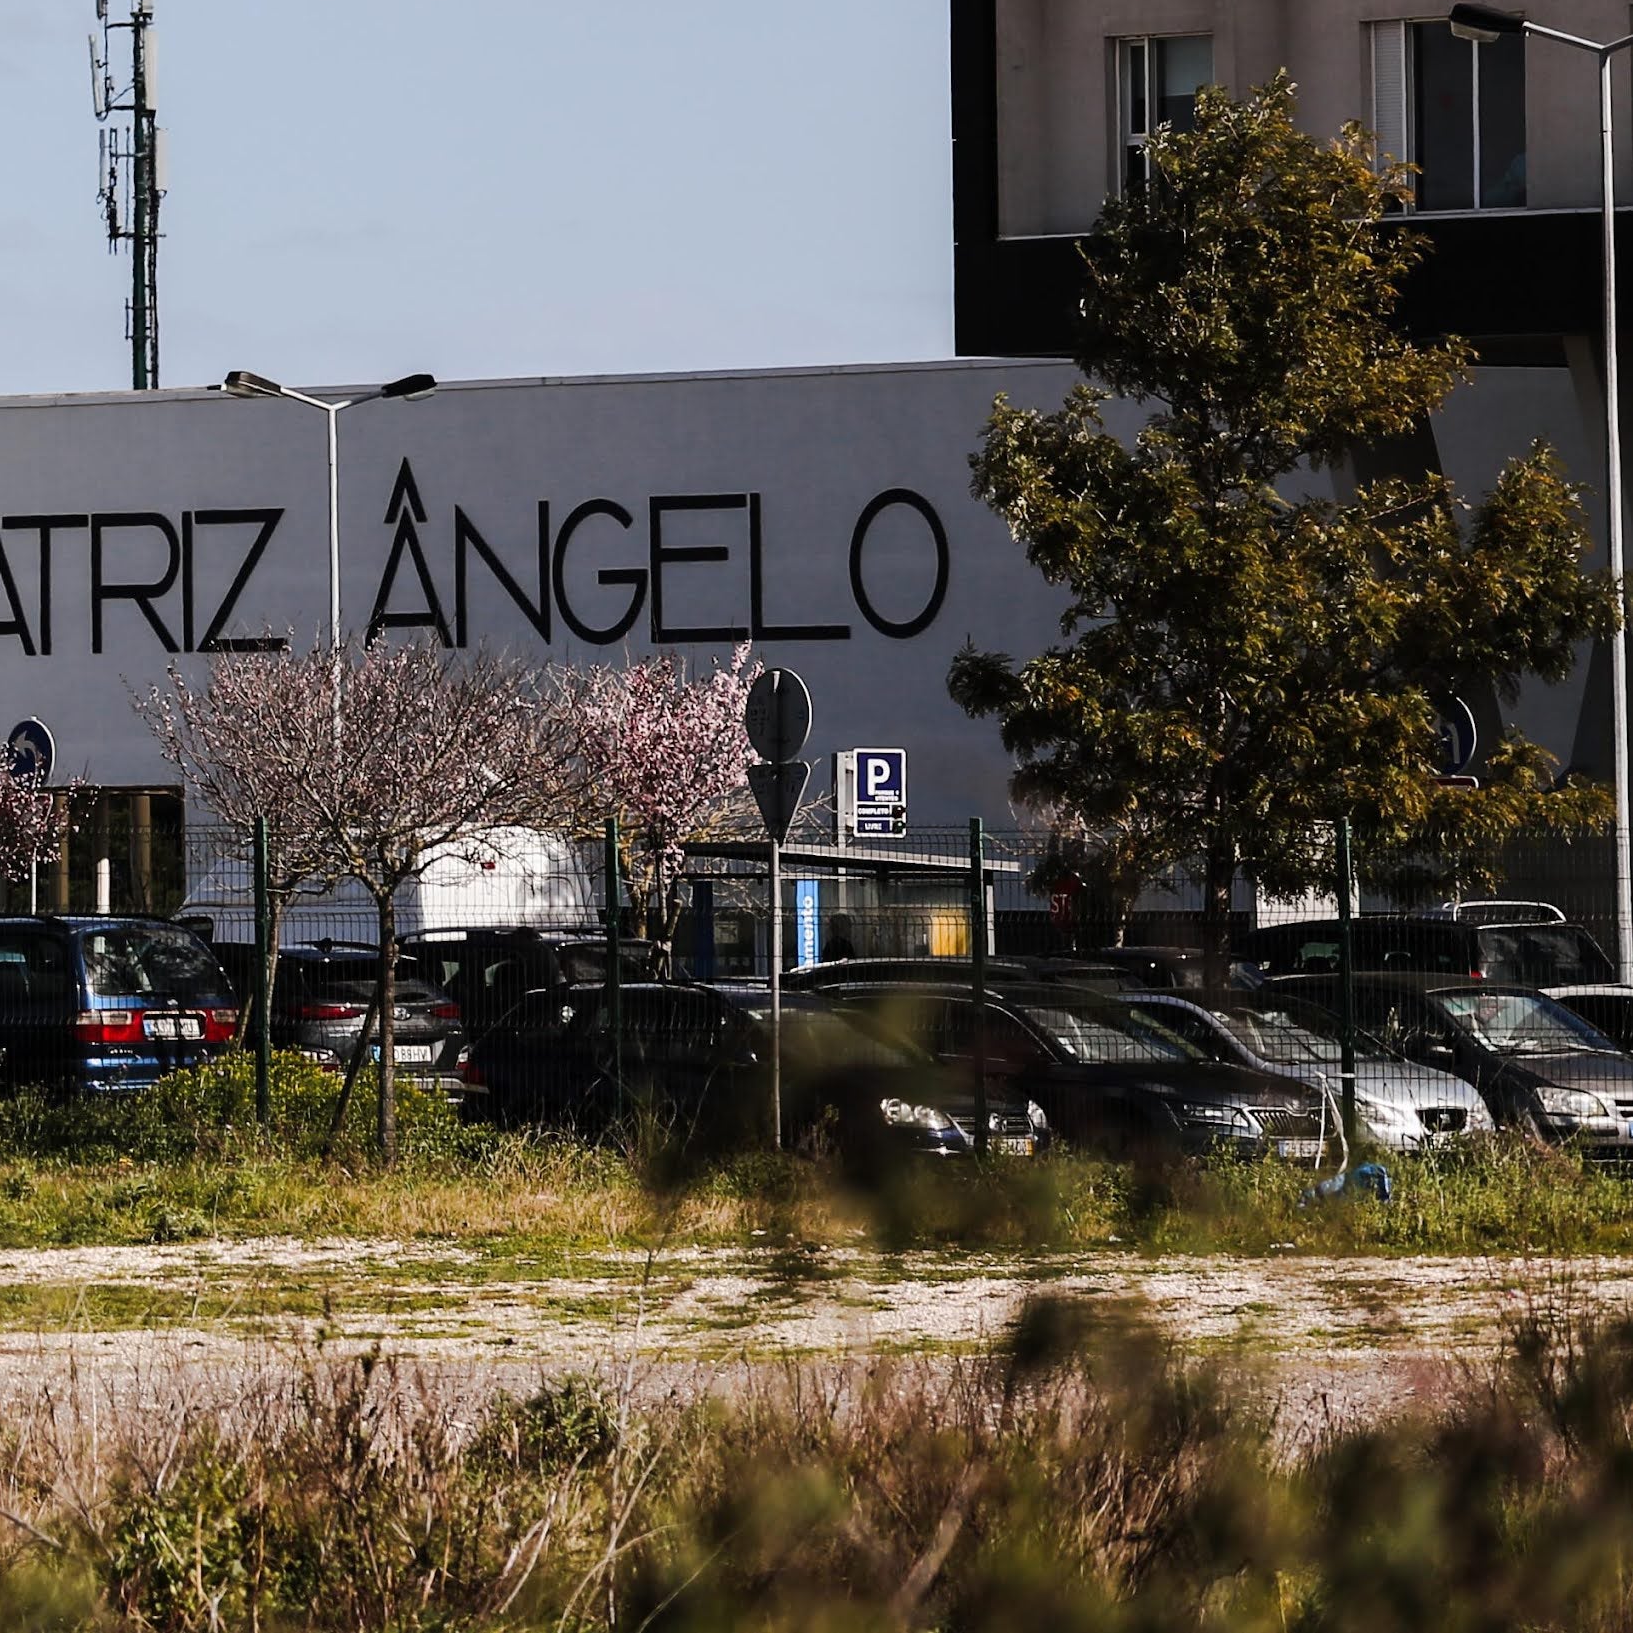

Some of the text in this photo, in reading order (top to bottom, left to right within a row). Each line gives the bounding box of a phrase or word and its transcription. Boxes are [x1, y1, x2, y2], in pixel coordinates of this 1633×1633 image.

[364, 456, 949, 648] ÂNGELO
[867, 758, 890, 796] P
[1051, 893, 1071, 914] ST
